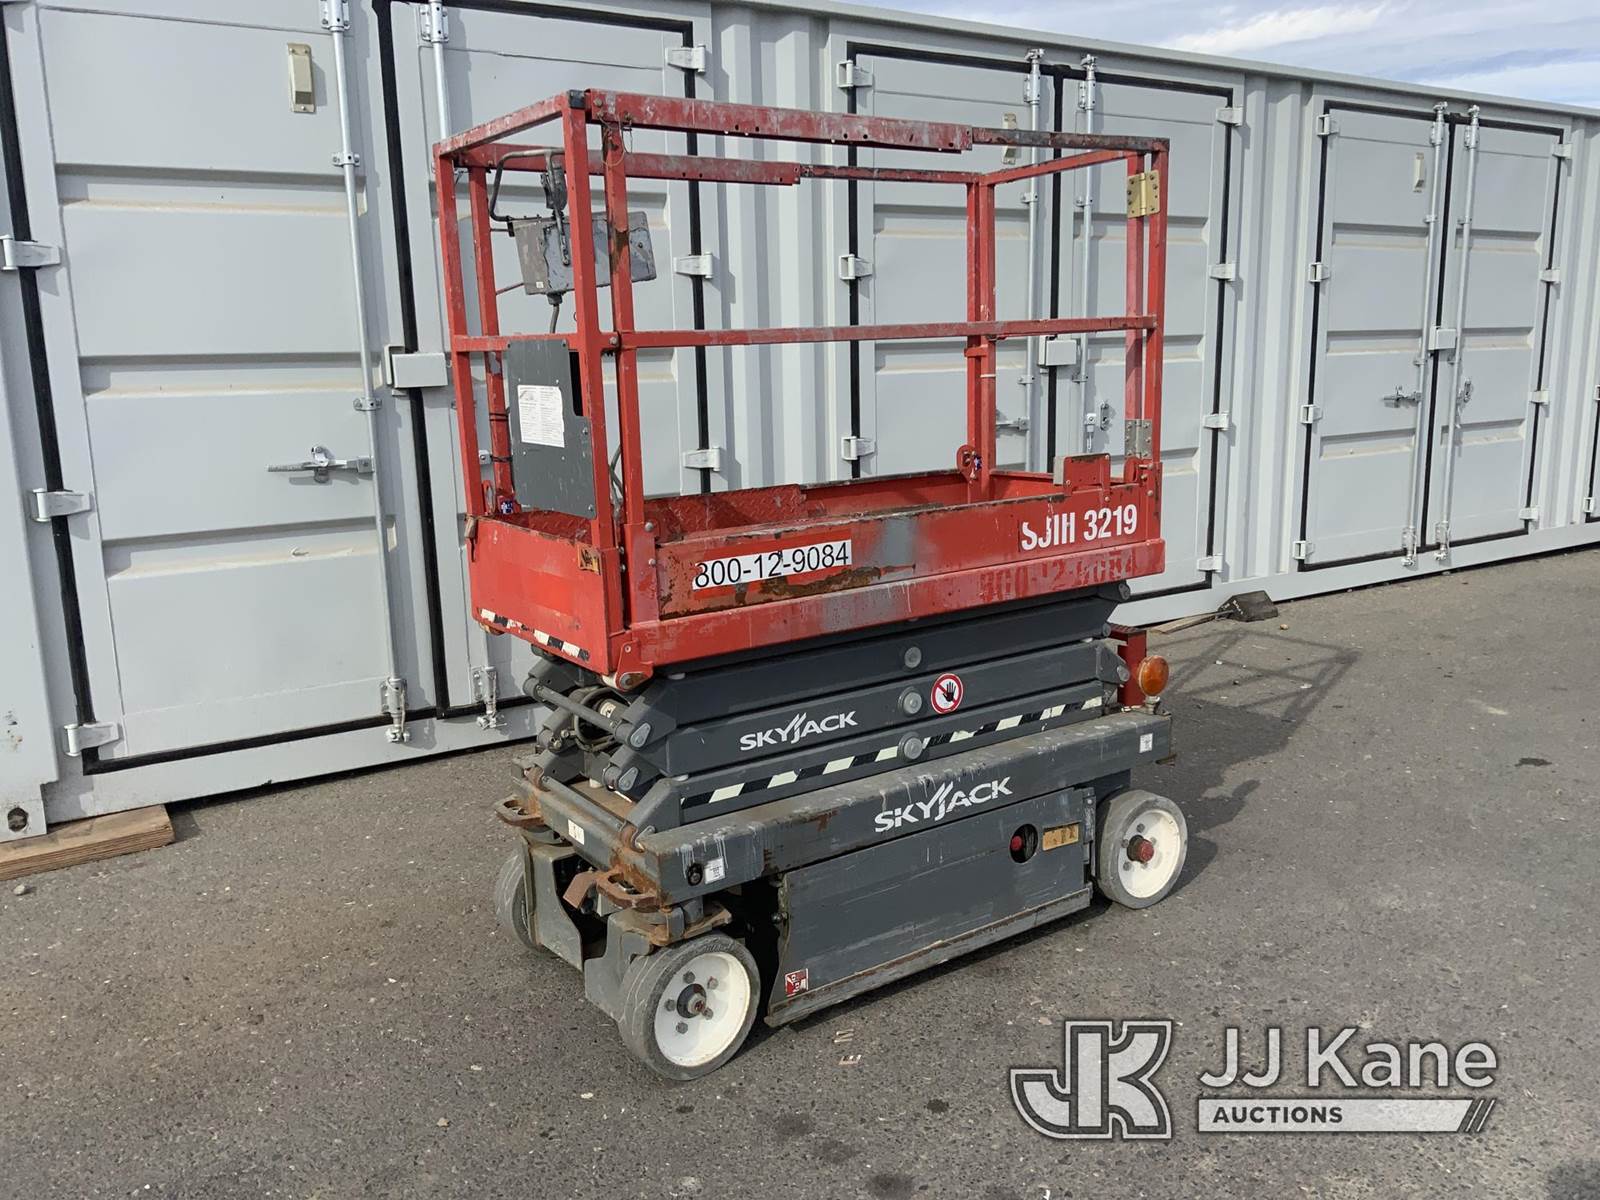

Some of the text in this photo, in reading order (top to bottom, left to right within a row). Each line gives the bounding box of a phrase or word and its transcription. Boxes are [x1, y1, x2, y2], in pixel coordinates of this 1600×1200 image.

[1083, 504, 1138, 541] 3219
[695, 542, 849, 588] 800-12-9084
[740, 710, 858, 751] SKYJACK
[874, 776, 1013, 833] SKYJACK
